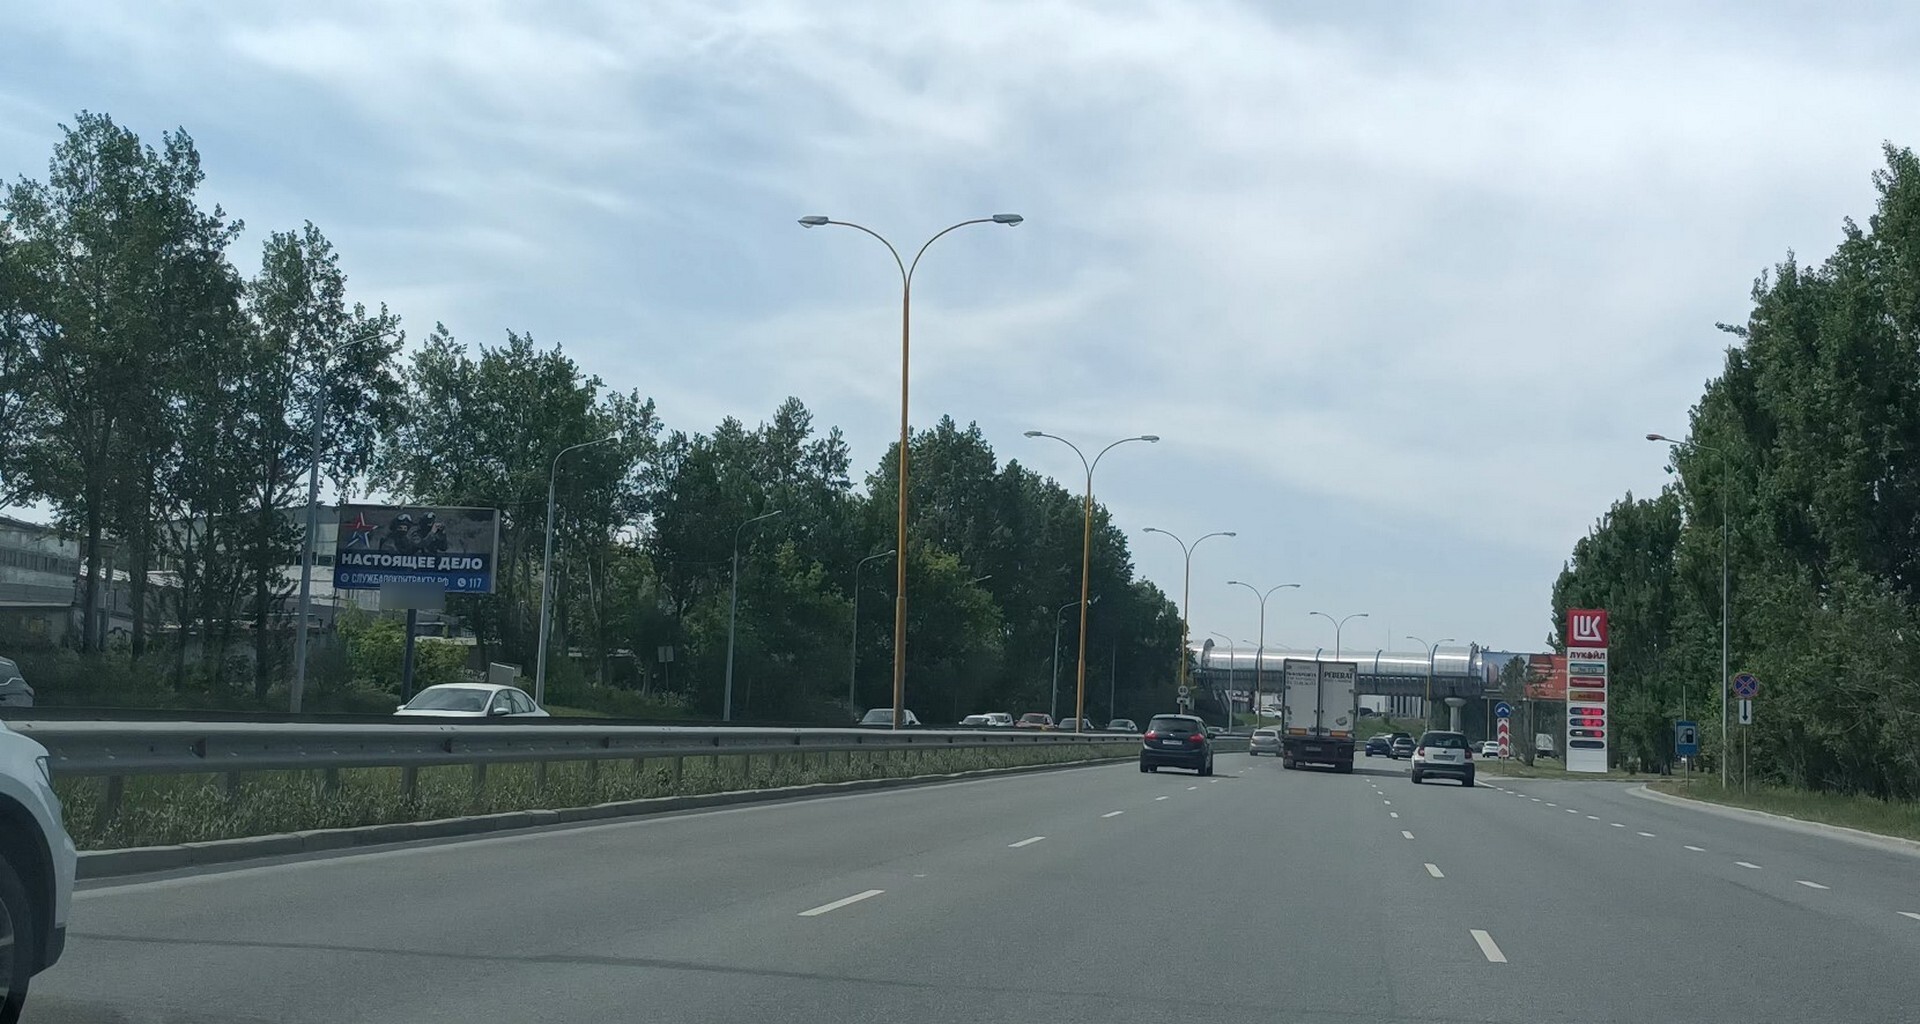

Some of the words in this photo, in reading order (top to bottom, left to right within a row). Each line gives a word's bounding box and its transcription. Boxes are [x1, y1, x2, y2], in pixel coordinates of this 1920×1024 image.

[341, 553, 435, 570] НАСТОЯЩЕЕ
[438, 557, 483, 571] ДЕЛО
[351, 573, 449, 586] СЛУЖБАПОКОНТРАКТУРФ
[469, 578, 482, 589] 117
